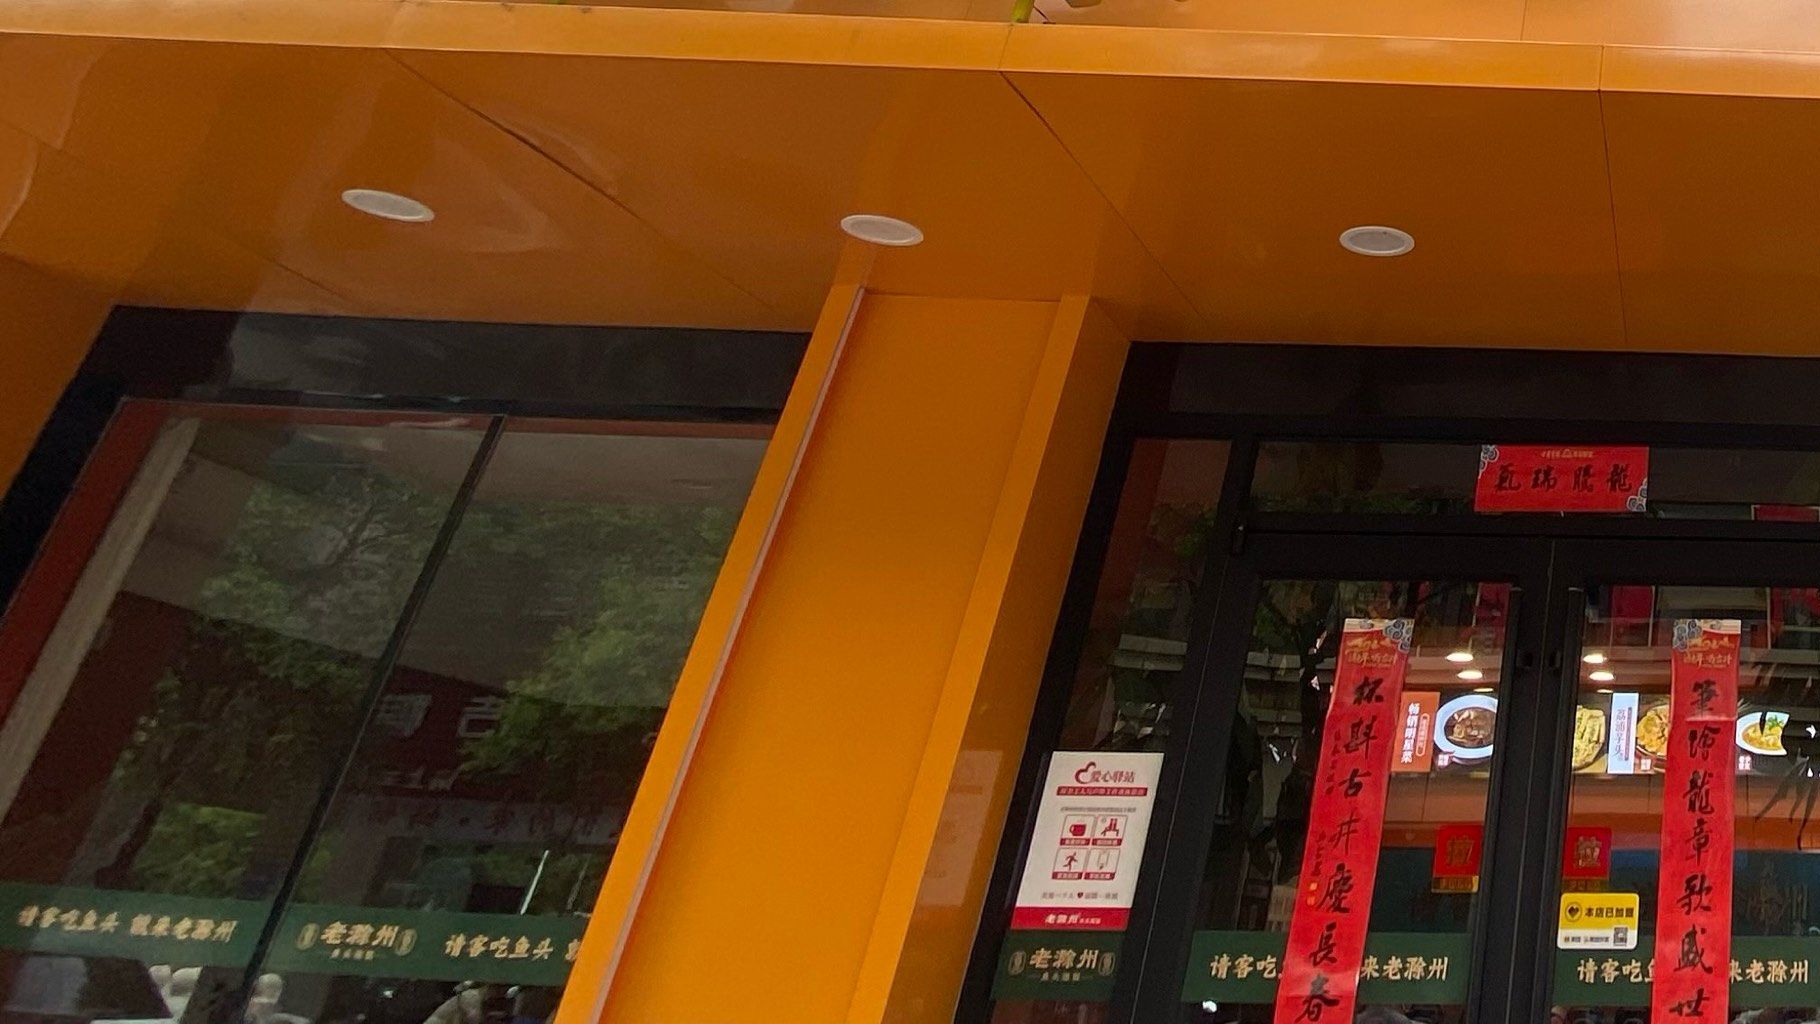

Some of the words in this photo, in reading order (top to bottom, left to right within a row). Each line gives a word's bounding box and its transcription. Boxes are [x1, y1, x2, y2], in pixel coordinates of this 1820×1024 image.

[1029, 947, 1099, 970] 老滁州
[1209, 953, 1282, 981] 请客吃
